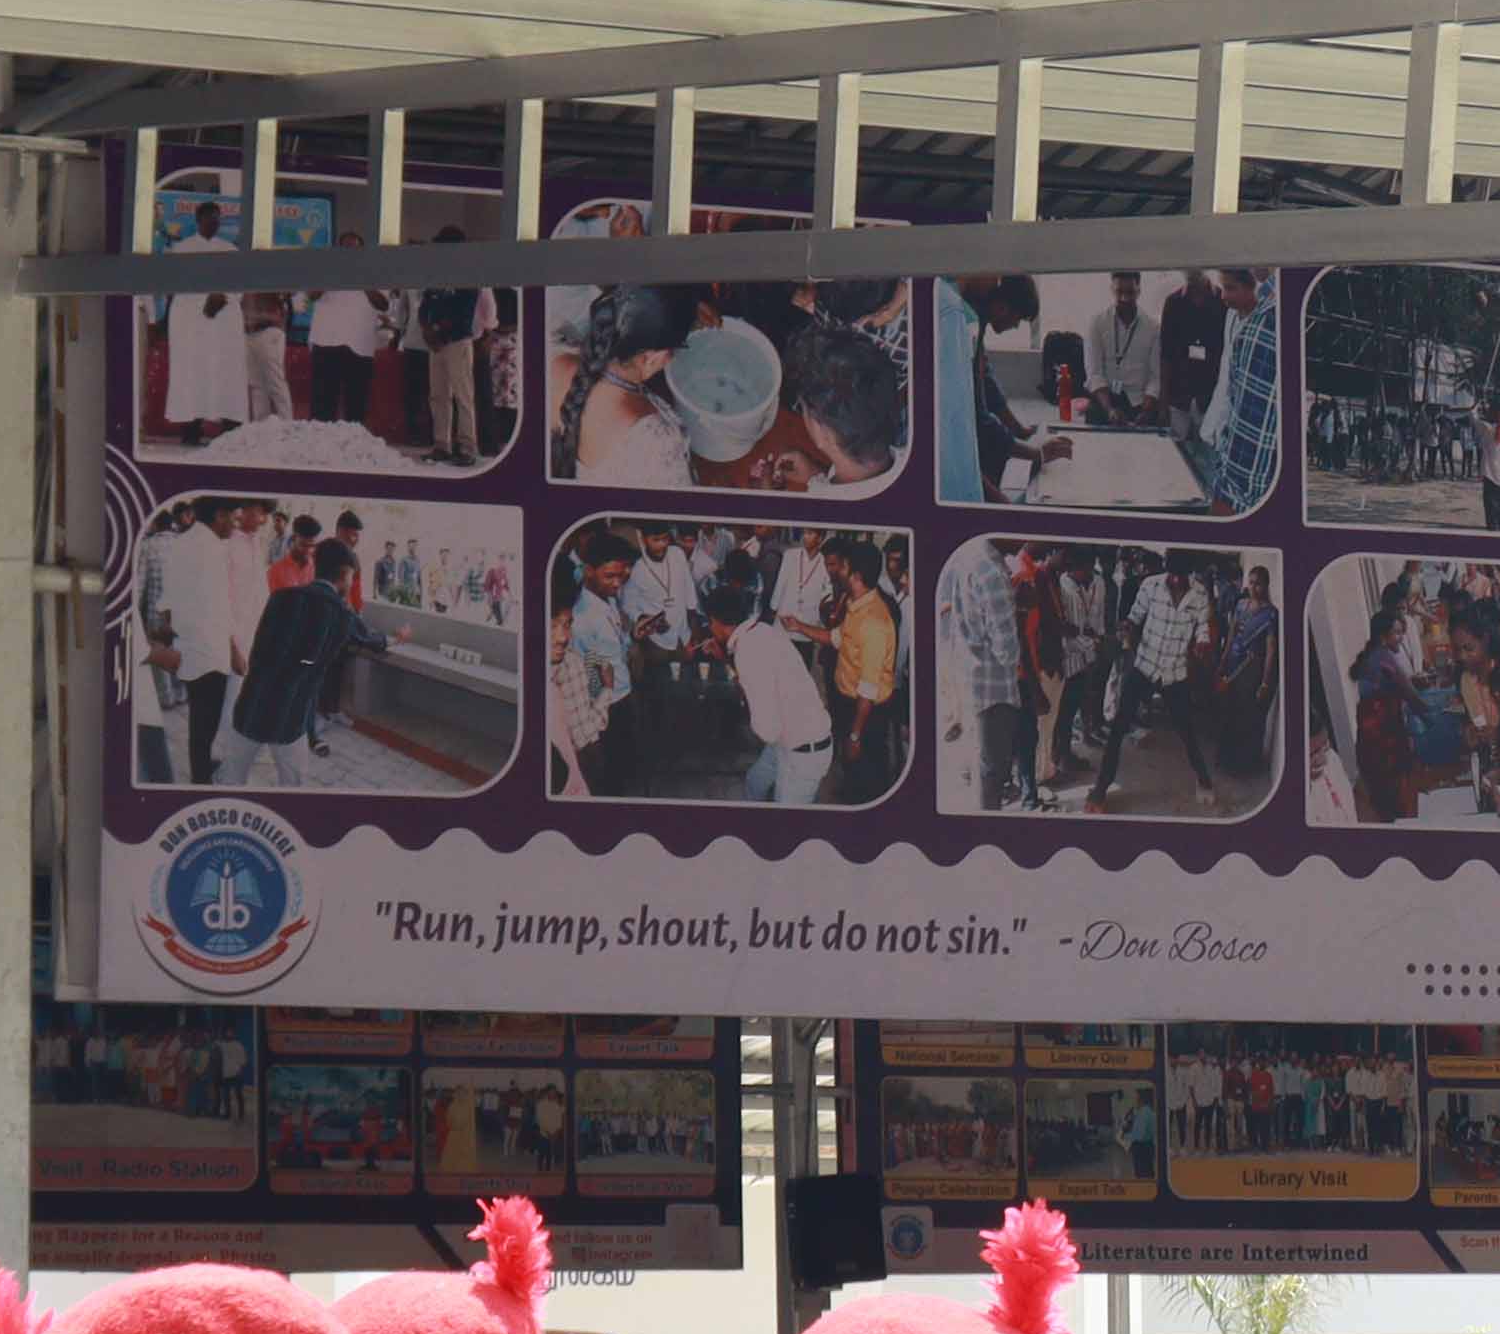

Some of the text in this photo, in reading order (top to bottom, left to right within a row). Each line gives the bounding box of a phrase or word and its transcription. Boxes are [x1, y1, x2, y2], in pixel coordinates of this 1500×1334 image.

[158, 823, 189, 855] DON
[187, 808, 239, 834] BOSCO
[240, 810, 298, 860] COLLEGE
[374, 900, 486, 949] "Run,
[492, 903, 609, 955] jump,
[616, 904, 739, 954] shout,
[747, 906, 815, 950] but
[820, 909, 868, 952] do
[876, 917, 942, 955] not
[946, 914, 1028, 956] sin."
[1079, 920, 1161, 962] Don
[1167, 920, 1269, 964] Bosco
[100, 1159, 164, 1179] Radio
[1242, 1169, 1348, 1193] Library Visit
[1080, 1243, 1370, 1262] Literature are Intertwined
[1459, 1235, 1490, 1249] Scan
